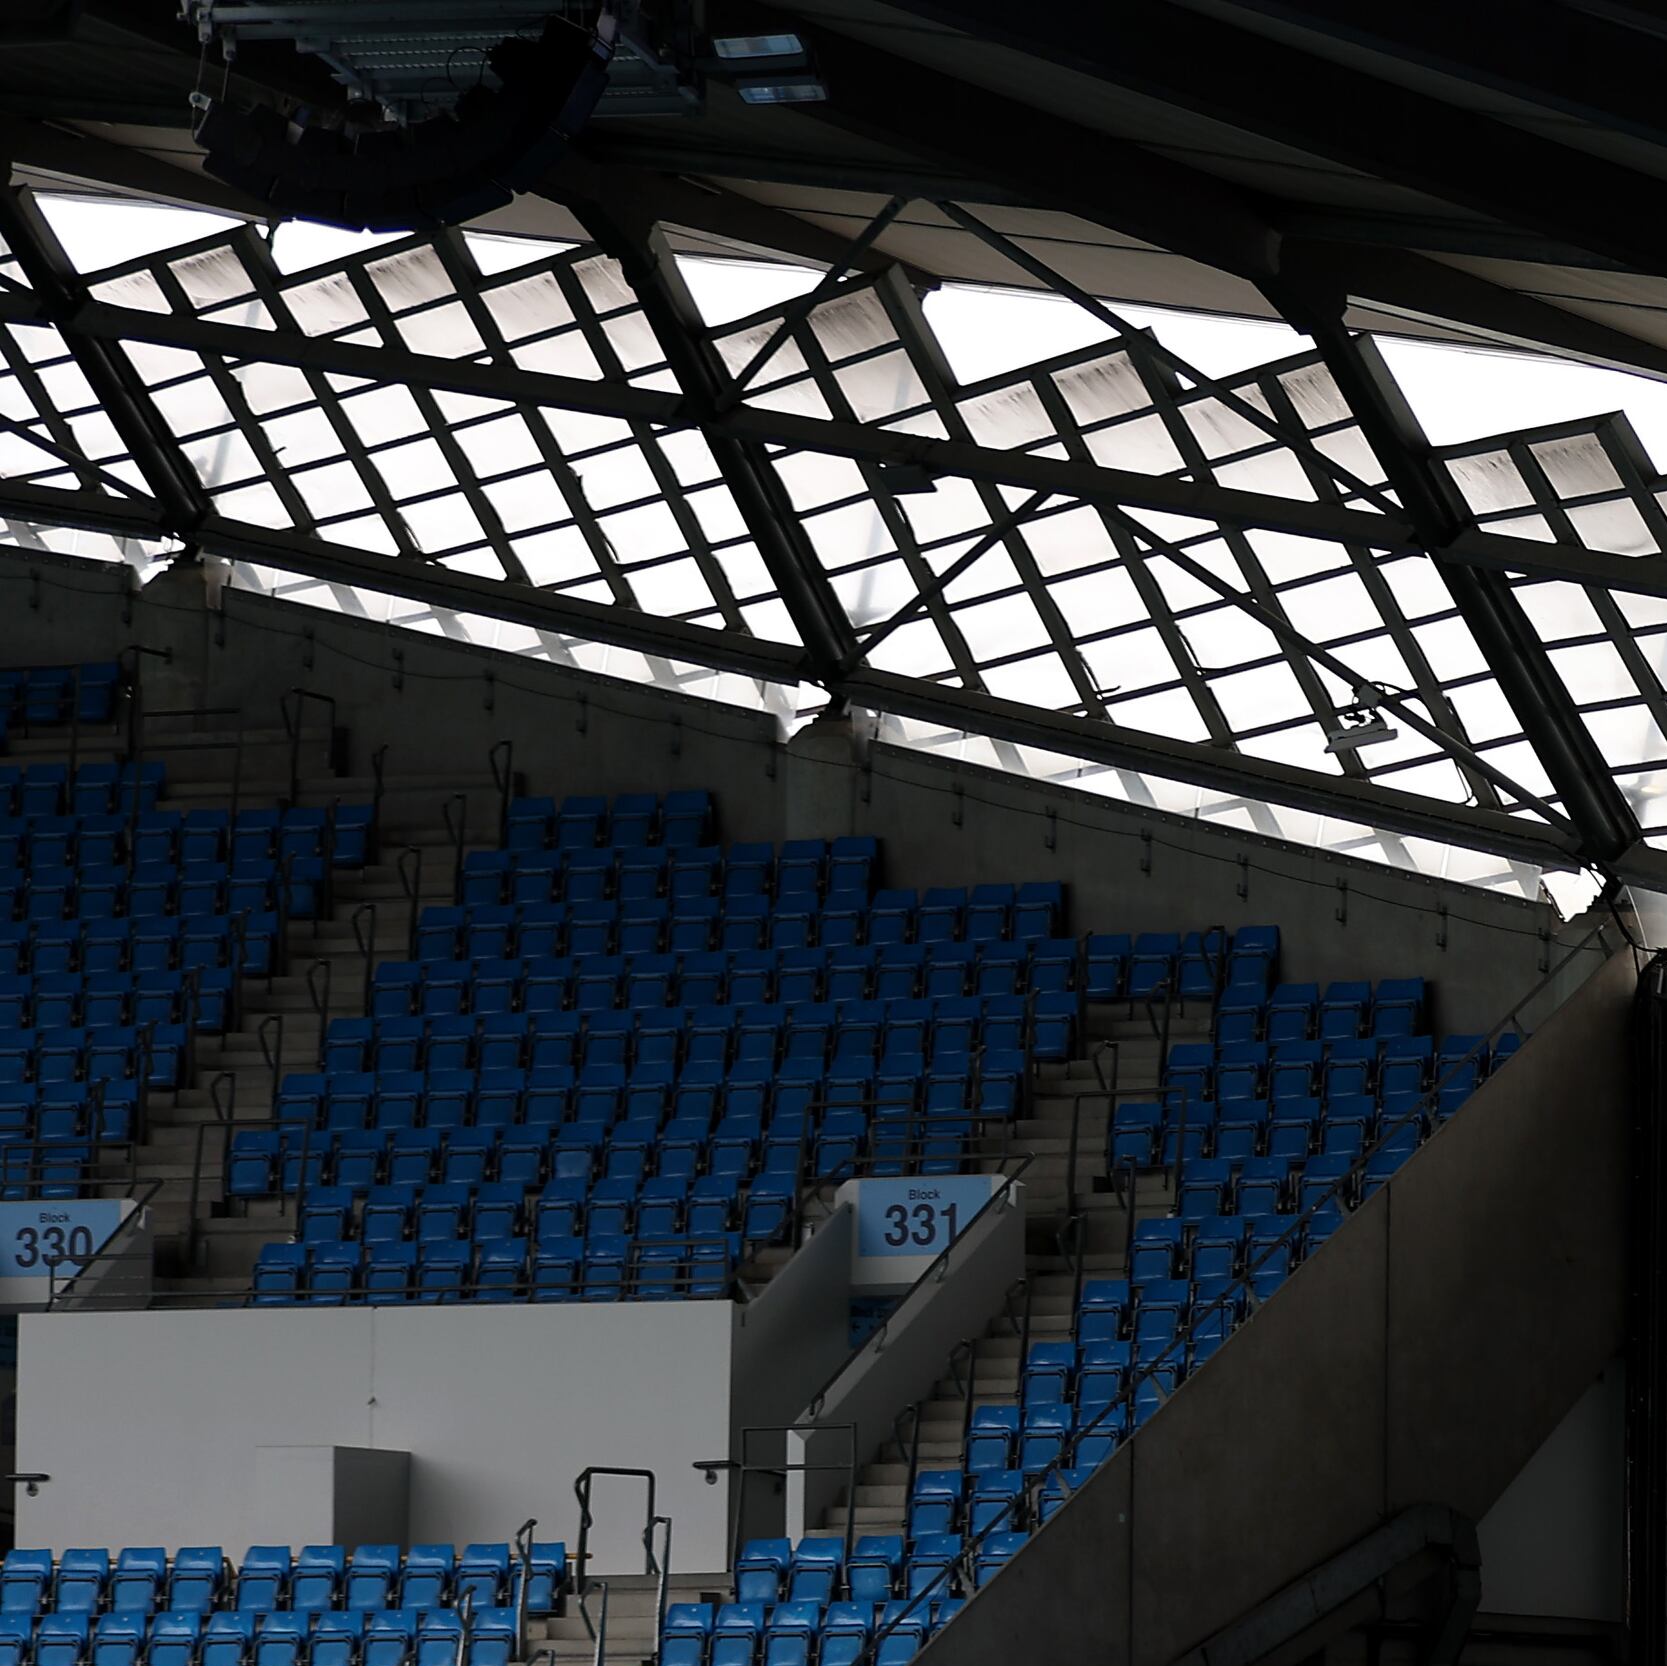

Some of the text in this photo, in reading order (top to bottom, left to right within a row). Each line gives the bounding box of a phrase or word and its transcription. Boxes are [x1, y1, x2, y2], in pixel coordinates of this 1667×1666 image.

[909, 1188, 941, 1200] Block
[39, 1211, 72, 1224] Block
[884, 1202, 957, 1247] 331
[15, 1225, 93, 1268] 330
